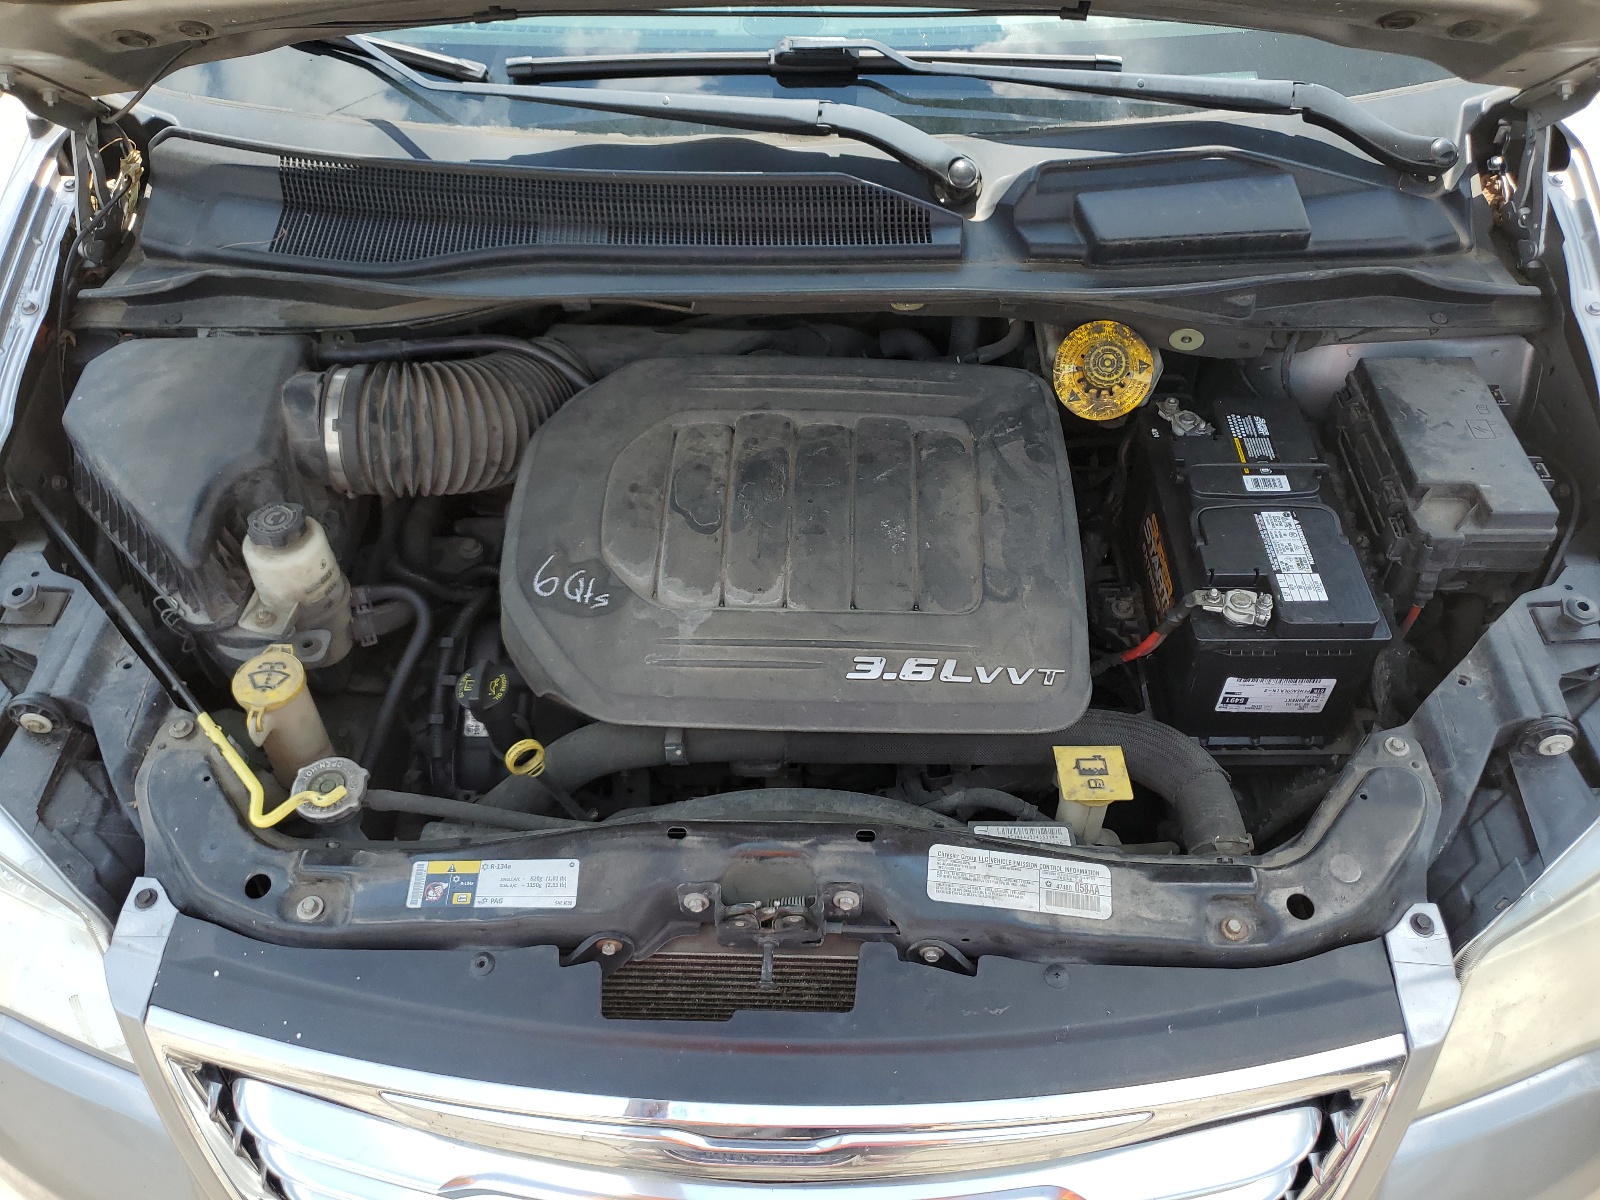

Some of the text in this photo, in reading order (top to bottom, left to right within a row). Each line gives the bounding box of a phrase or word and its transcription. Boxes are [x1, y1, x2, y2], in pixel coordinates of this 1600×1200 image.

[533, 554, 560, 597] 6
[492, 692, 503, 701] OIL
[937, 850, 959, 860] Chrysler
[960, 853, 977, 863] Group
[990, 857, 1012, 866] VEHICLE
[1013, 860, 1038, 869] EMISSION
[1040, 863, 1063, 872] CONTROL
[1064, 866, 1101, 877] INFORMATION
[1074, 883, 1100, 895] 058AA
[490, 897, 504, 905] PAG
